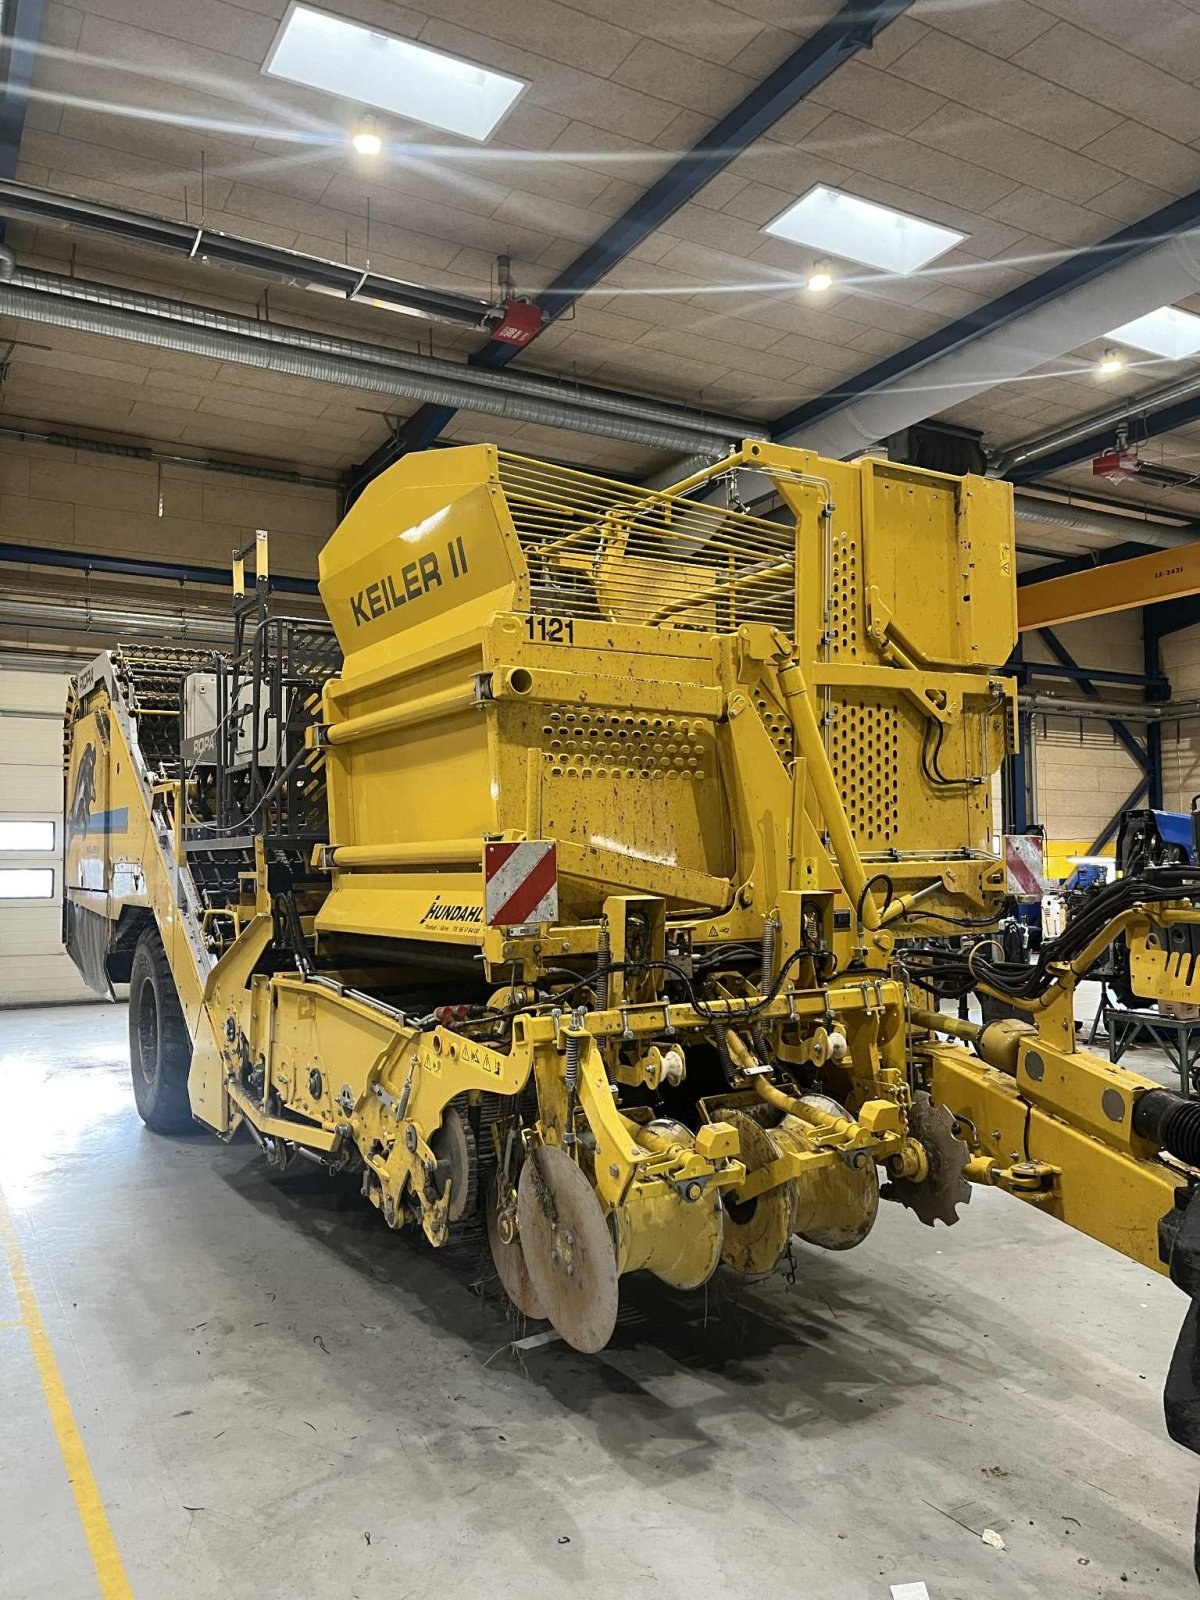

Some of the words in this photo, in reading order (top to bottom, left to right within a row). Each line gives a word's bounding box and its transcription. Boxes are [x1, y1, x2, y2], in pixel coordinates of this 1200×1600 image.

[350, 552, 442, 627] KEILER
[447, 536, 468, 578] II
[525, 616, 573, 643] 1121
[193, 736, 215, 755] ROPA
